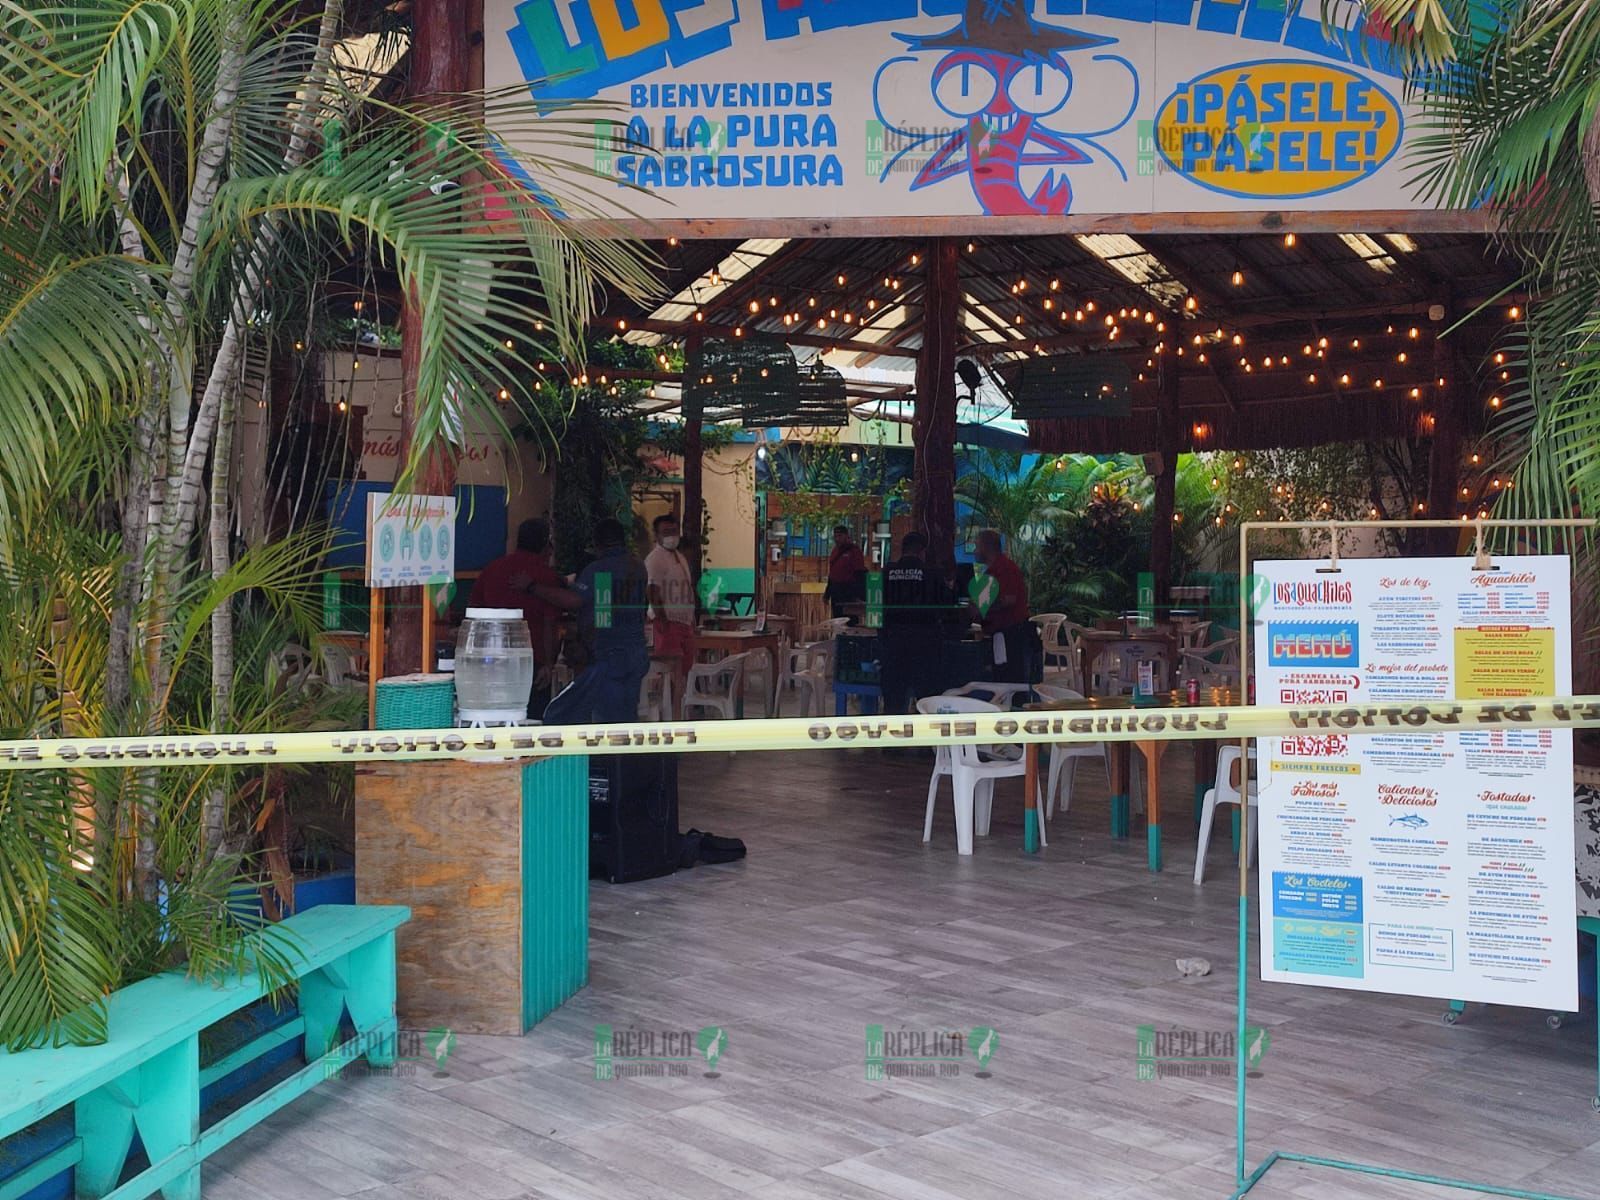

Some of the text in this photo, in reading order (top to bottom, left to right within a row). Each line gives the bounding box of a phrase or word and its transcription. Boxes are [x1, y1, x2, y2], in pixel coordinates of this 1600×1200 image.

[631, 82, 832, 108] BIENVENIDOS
[1175, 73, 1386, 128] ¡PÁSELE,
[630, 114, 837, 148] A LA PURA
[1182, 122, 1378, 173] PÁSELE!
[618, 154, 843, 188] SABROSURA
[1471, 573, 1536, 586] Aguachiles
[1273, 629, 1352, 658] MENÚ
[1379, 664, 1401, 674] mejor
[1478, 703, 1538, 725] DE
[929, 720, 977, 736] EL
[1291, 786, 1336, 797] Famosos
[1378, 784, 1425, 795] Calientes
[1481, 791, 1531, 802] Tostadas
[1382, 795, 1437, 806] Deliciosos
[1284, 875, 1303, 888] Los
